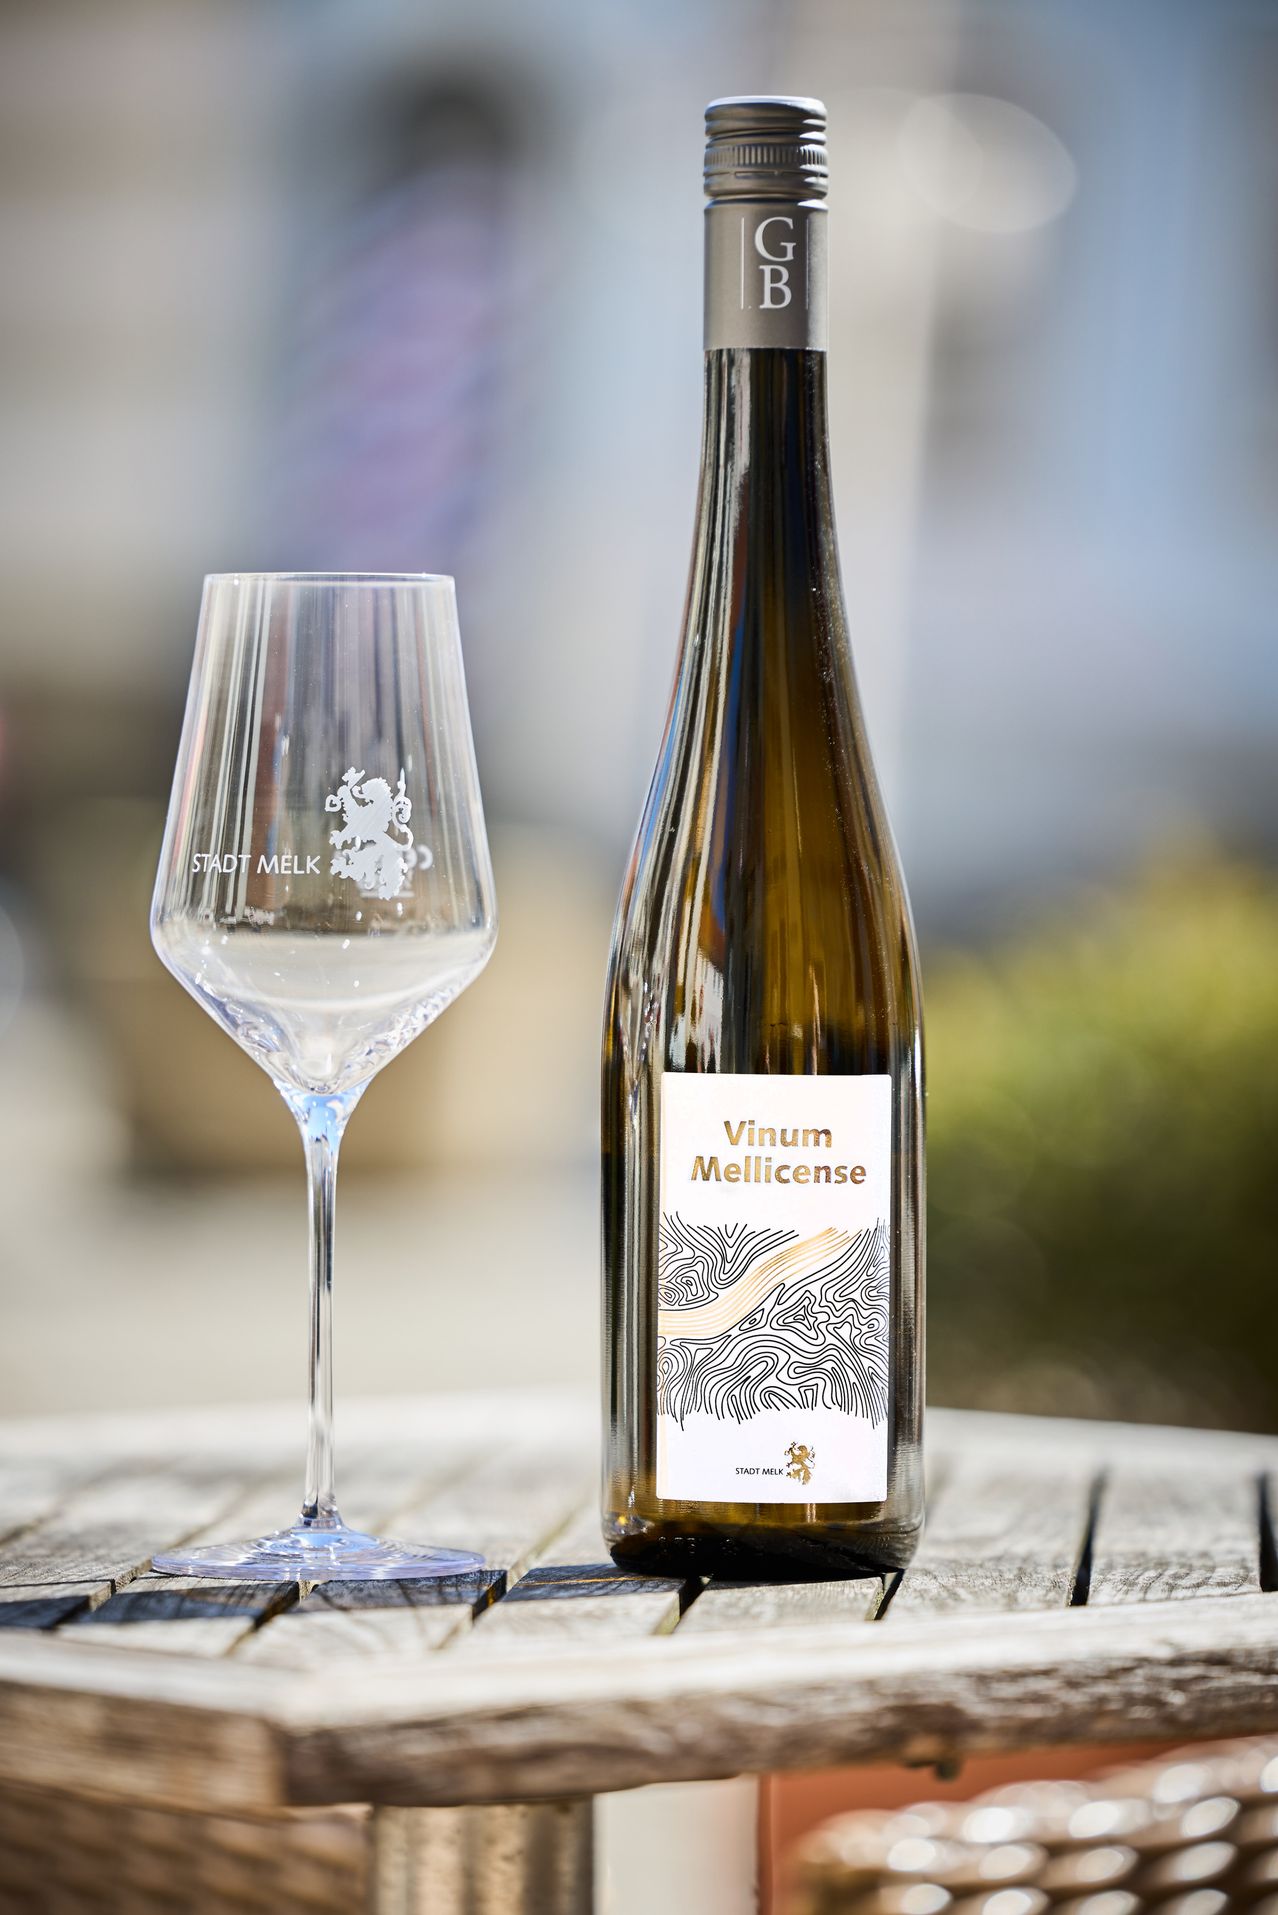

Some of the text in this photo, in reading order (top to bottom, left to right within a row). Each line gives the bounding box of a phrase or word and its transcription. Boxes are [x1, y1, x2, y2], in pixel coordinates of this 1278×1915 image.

[754, 216, 797, 262] G
[758, 264, 793, 309] B
[192, 853, 321, 875] STADT MELK
[723, 1119, 832, 1148] Vinum
[690, 1155, 867, 1185] Mellicense
[735, 1467, 784, 1476] STADT MELK
